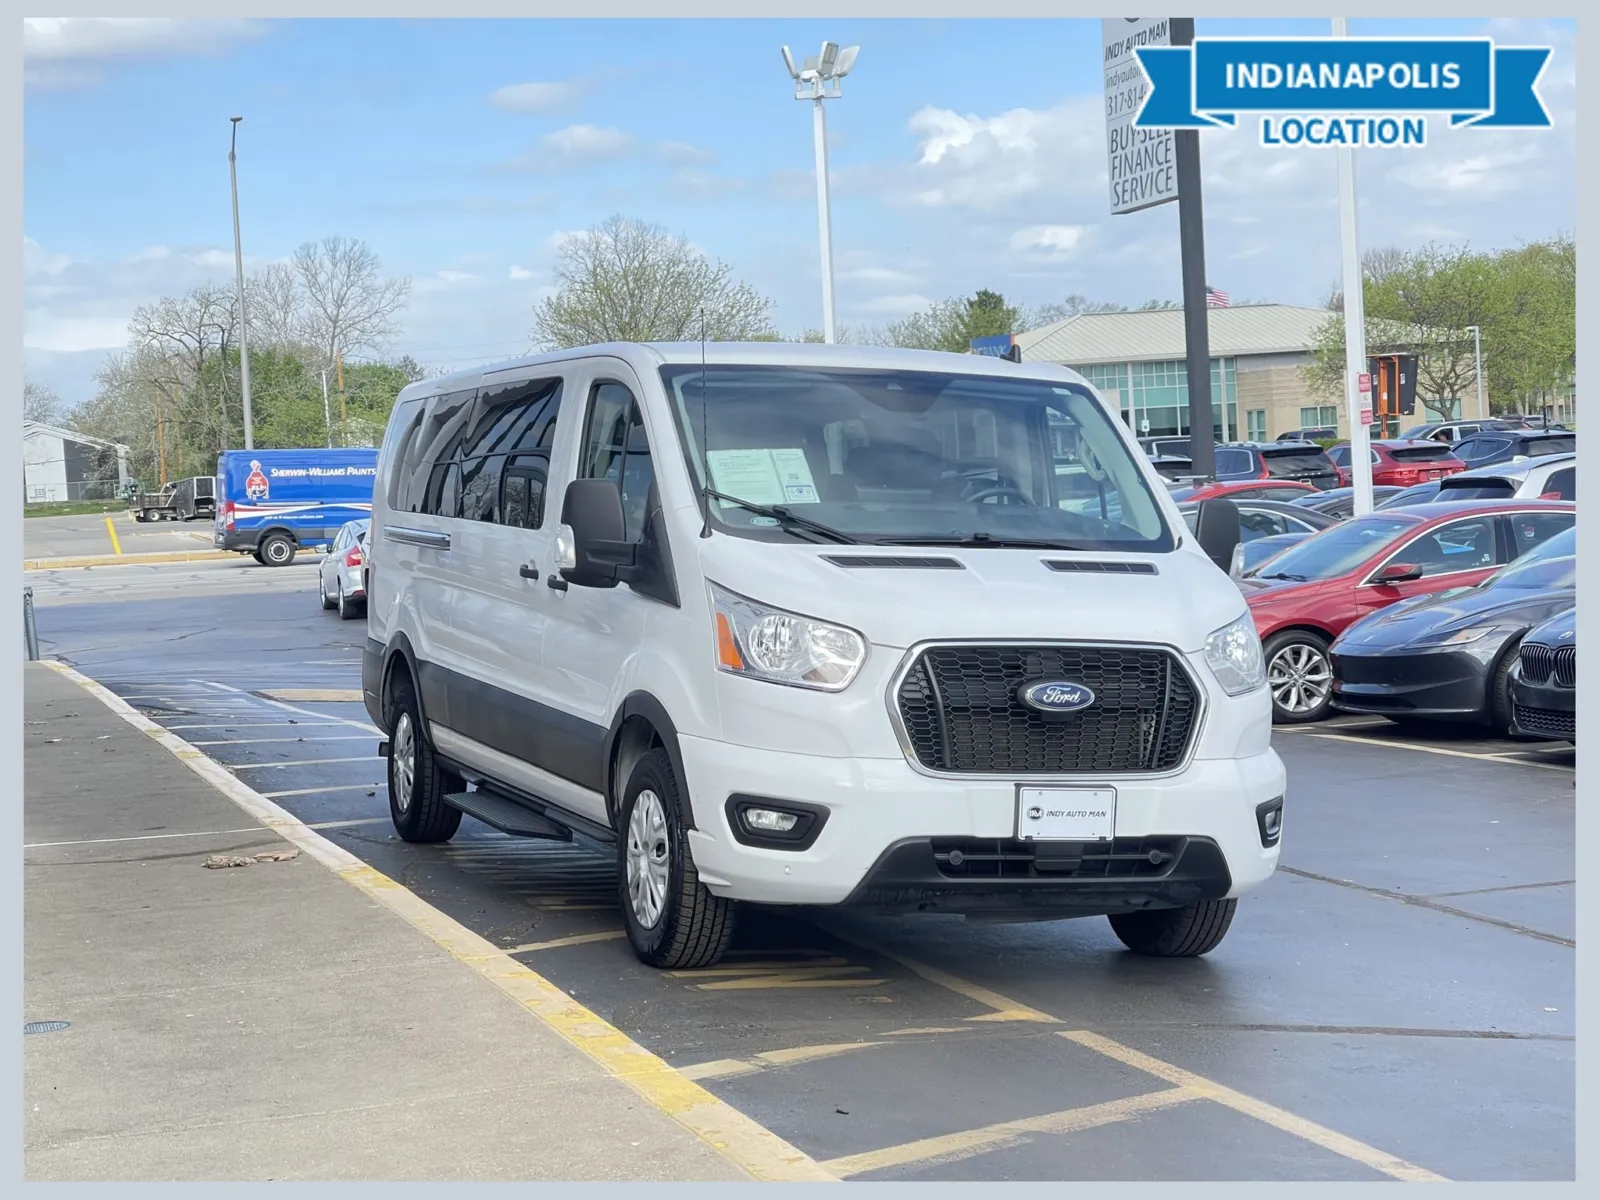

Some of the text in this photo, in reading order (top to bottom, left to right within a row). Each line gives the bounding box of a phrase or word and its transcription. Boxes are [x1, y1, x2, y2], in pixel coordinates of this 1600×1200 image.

[1105, 20, 1168, 61] INDY AUTO MAN
[1112, 137, 1172, 180] FINANCE
[1113, 166, 1173, 206] SERVICE
[1043, 686, 1081, 703] Ford
[1065, 810, 1087, 818] AUTO
[1087, 810, 1107, 818] MAN
